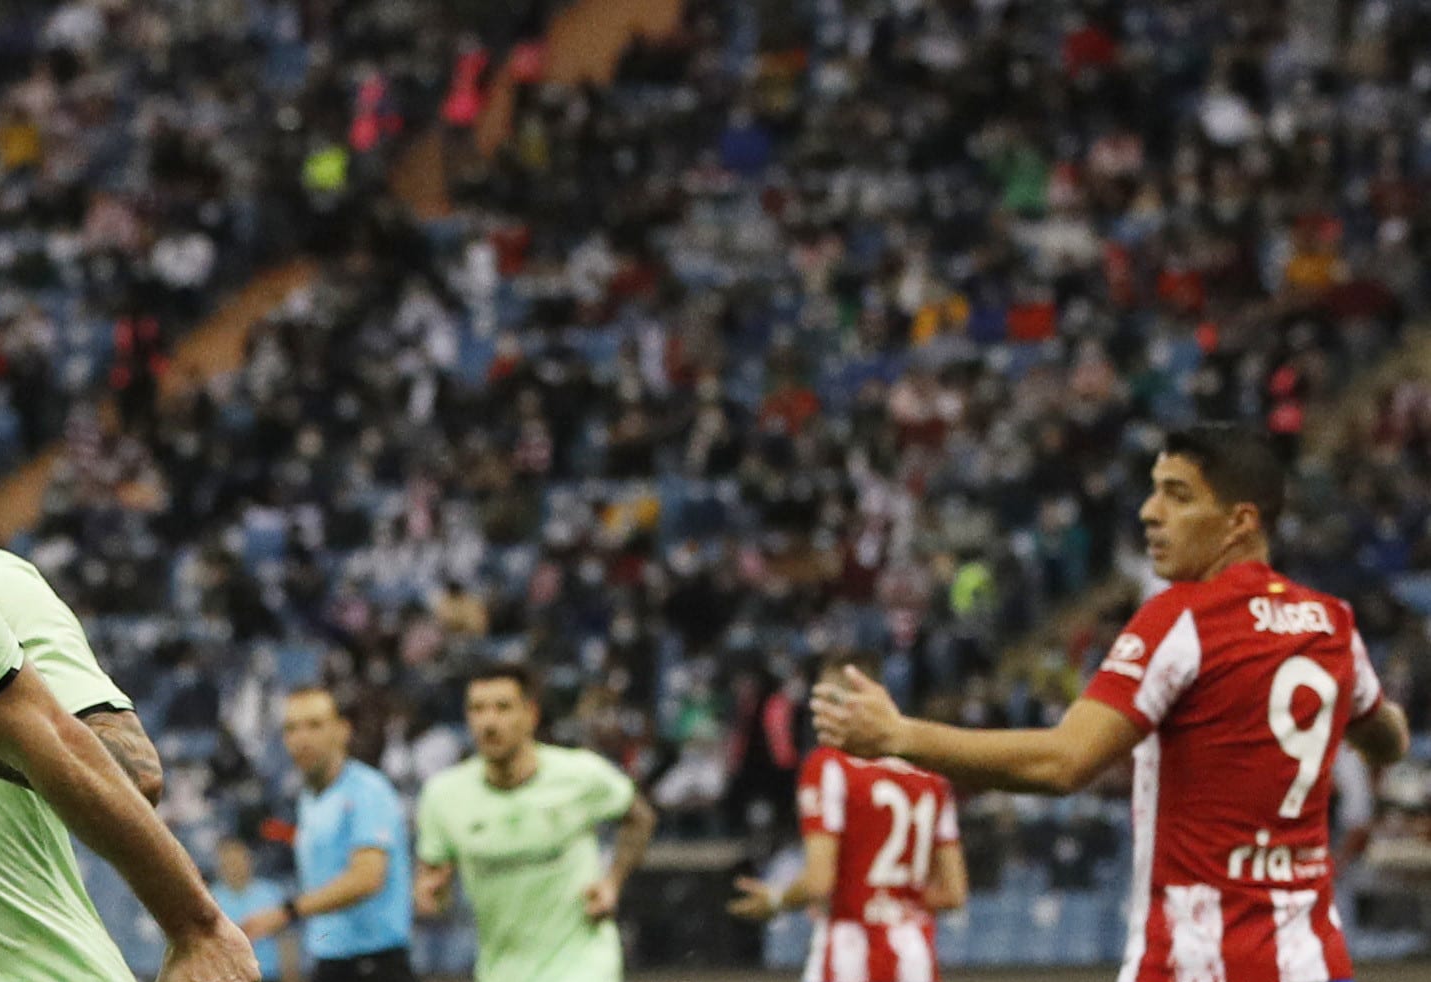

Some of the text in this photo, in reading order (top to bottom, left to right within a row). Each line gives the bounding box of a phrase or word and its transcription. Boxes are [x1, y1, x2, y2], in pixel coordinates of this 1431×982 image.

[1268, 654, 1338, 819] 9
[866, 779, 937, 888] 21
[1227, 828, 1295, 882] ria
